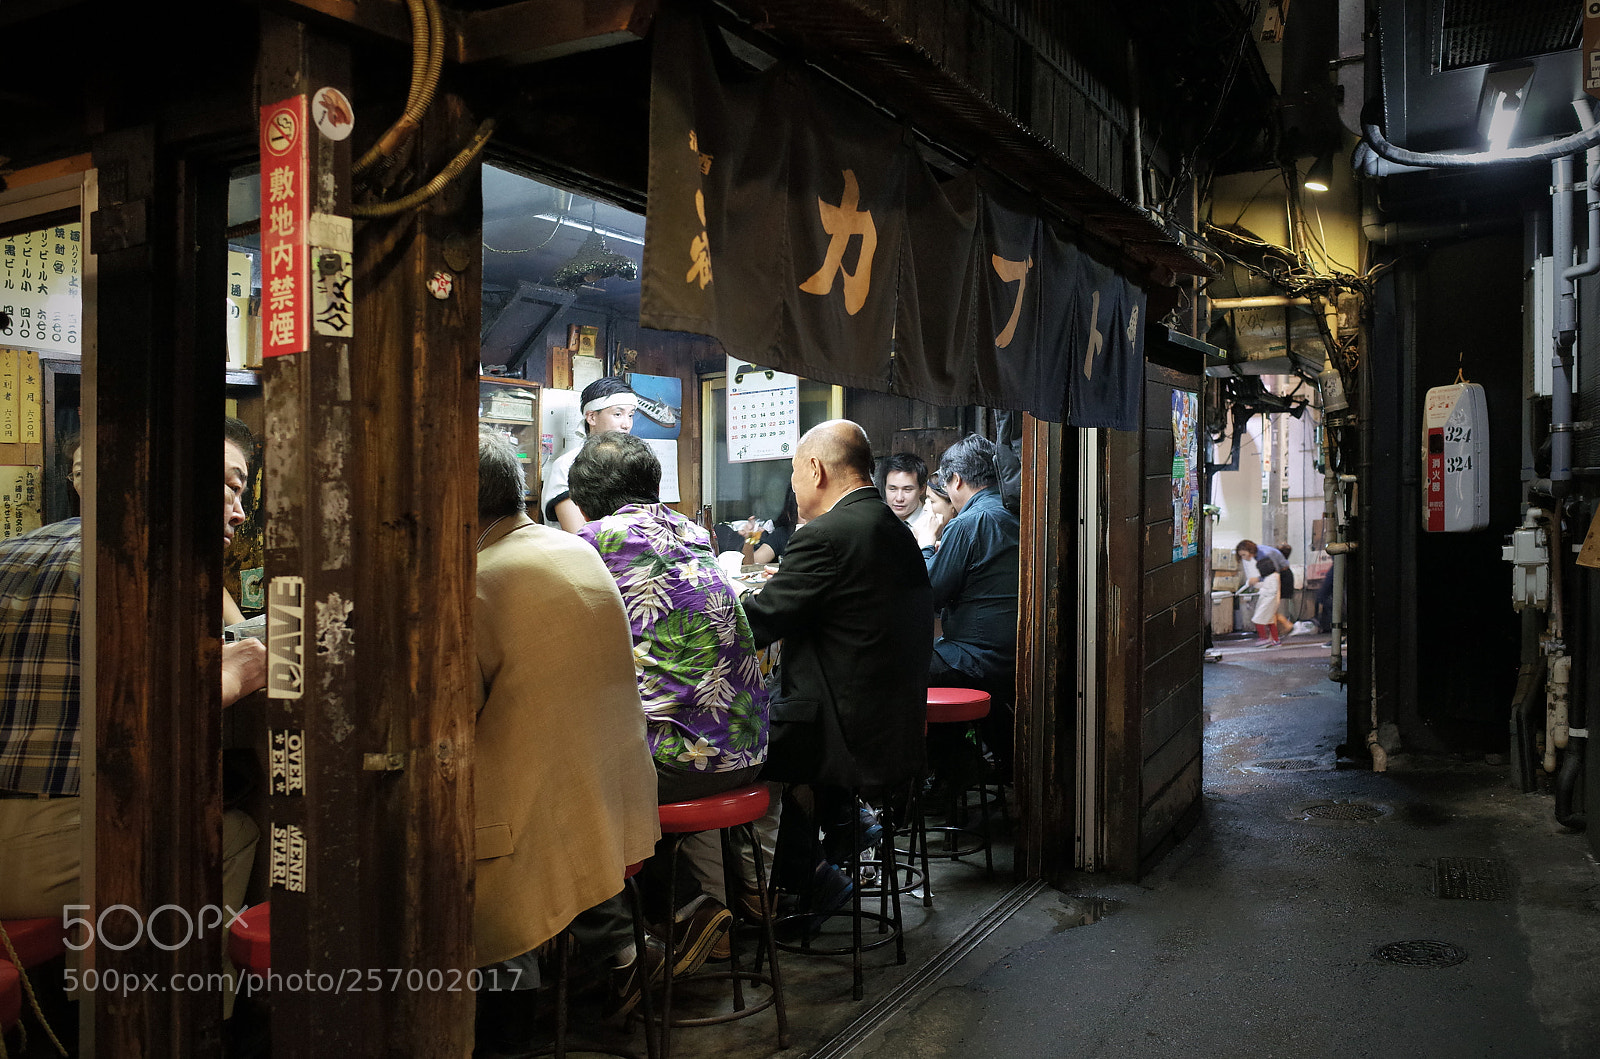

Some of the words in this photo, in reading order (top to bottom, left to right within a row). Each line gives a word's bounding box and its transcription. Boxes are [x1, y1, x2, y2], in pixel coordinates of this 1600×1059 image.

[37, 228, 48, 295] リンビール大
[268, 164, 295, 347] 敷地内禁煙
[1445, 426, 1472, 443] 324
[1431, 458, 1441, 492] 消火器
[1447, 455, 1472, 473] 324
[288, 734, 302, 790] OVER
